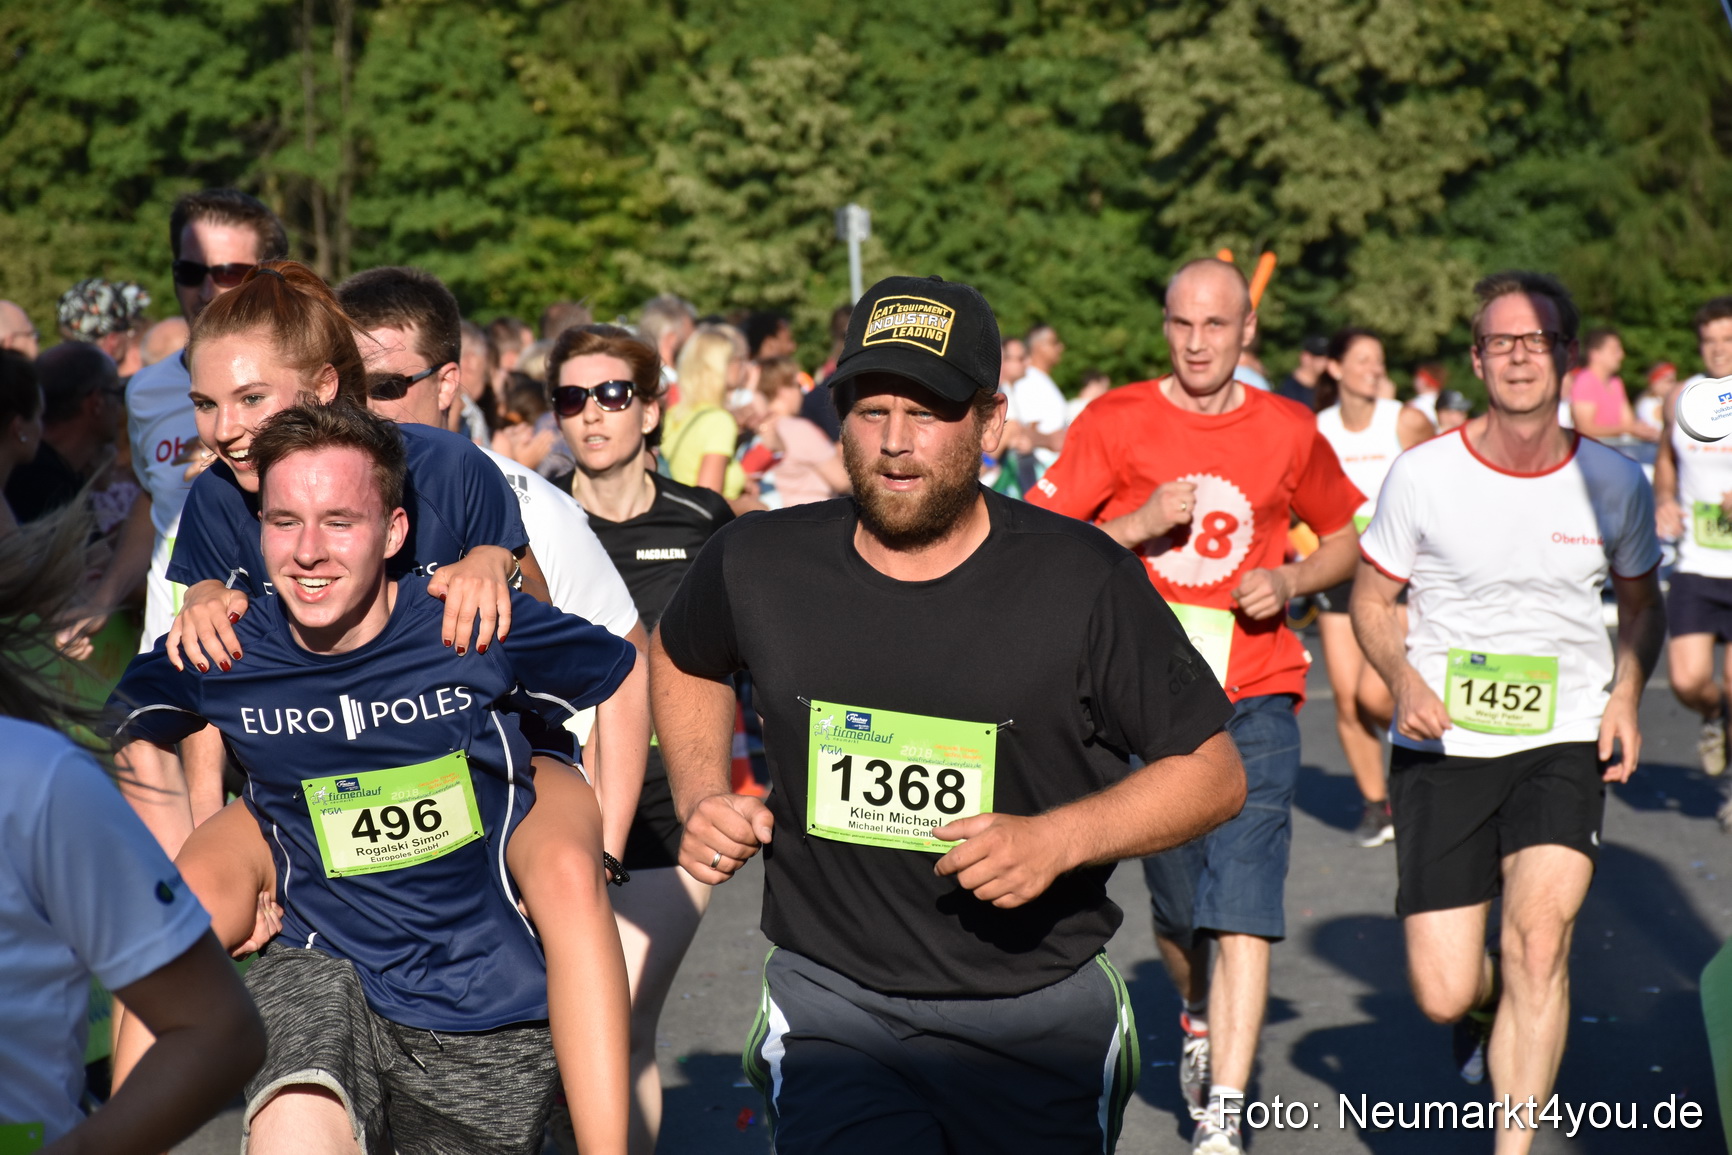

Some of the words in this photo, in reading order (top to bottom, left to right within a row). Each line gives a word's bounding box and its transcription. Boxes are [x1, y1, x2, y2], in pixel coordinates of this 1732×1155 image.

[873, 304, 896, 321] CAT
[896, 303, 949, 317] EQUIPMENT
[868, 313, 948, 334] INDUSTRY
[892, 326, 943, 342] LEADING
[635, 547, 688, 561] MAGDALENA
[1460, 678, 1543, 713] 1452
[240, 706, 335, 735] EURO
[370, 686, 473, 728] POLES
[833, 725, 895, 745] firmenlauf
[899, 745, 933, 759] 2018
[328, 785, 382, 802] firmenlauf
[391, 788, 420, 801] 2018
[830, 754, 966, 816] 1368
[351, 798, 443, 844] 496
[850, 806, 885, 822] Klein
[888, 811, 942, 829] Michael
[848, 820, 884, 833] Michael
[885, 825, 911, 836] Klein
[912, 828, 936, 838] Gmb
[355, 841, 409, 857] Rogalski
[411, 829, 450, 848] Simon
[370, 850, 413, 864] Europoles
[413, 842, 440, 856] GmbH
